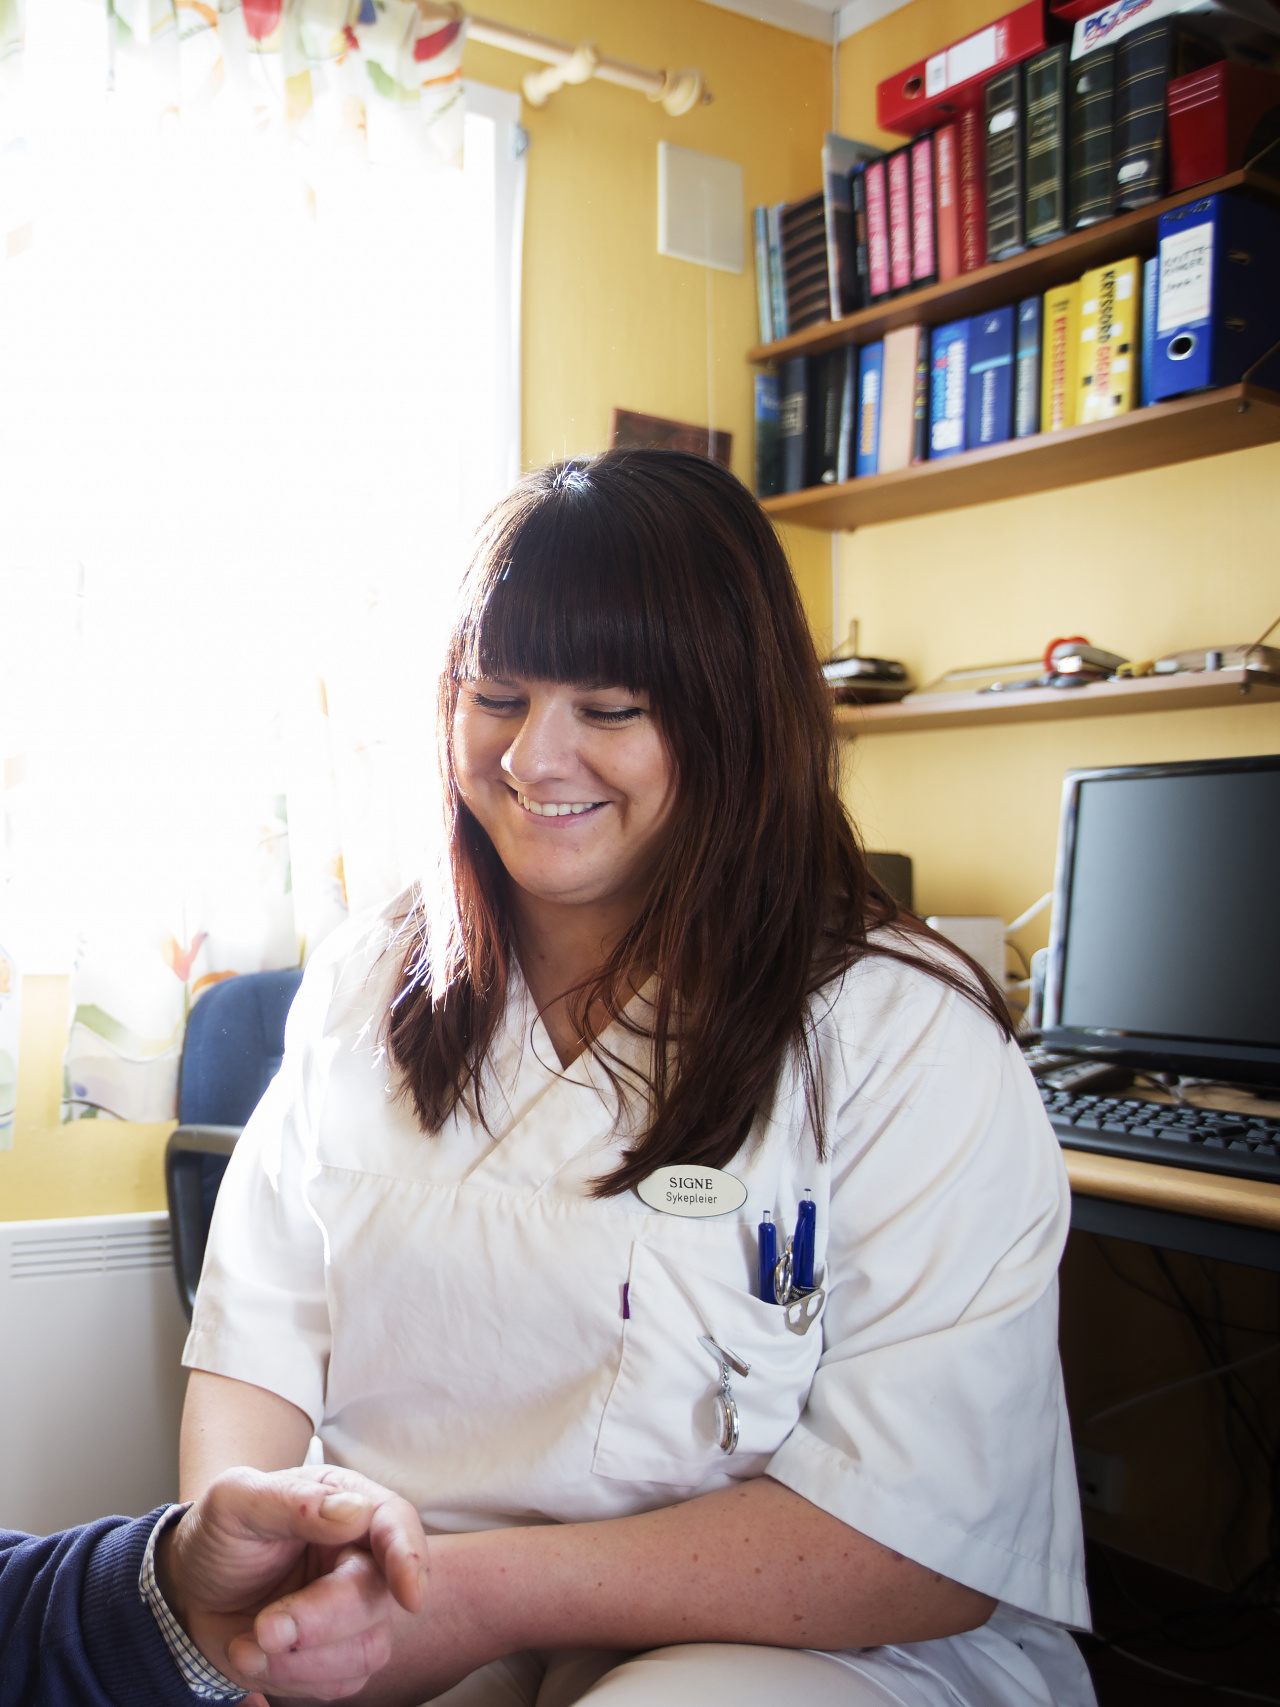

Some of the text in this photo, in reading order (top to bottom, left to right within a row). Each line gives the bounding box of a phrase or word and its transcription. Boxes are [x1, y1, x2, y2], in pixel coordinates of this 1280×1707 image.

[1097, 269, 1116, 344] KRYSSORD
[669, 1177, 713, 1189] SIGNE
[666, 1192, 717, 1204] Sykepleier
